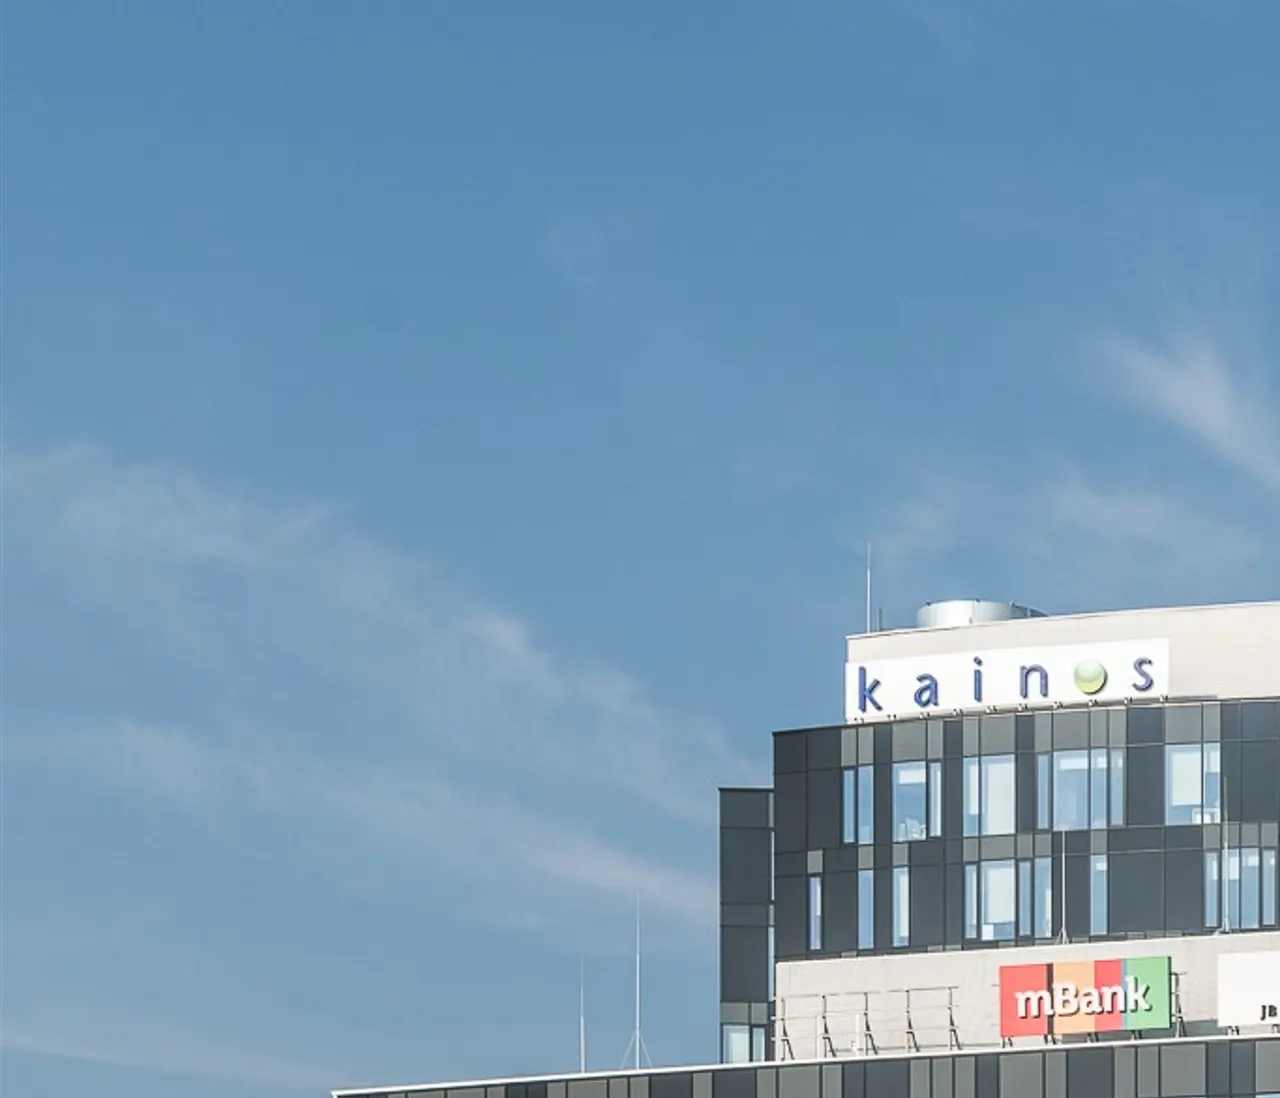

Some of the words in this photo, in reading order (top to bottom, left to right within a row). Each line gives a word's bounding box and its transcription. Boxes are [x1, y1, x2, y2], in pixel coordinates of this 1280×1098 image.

[858, 656, 1155, 713] kainos
[1015, 975, 1153, 1019] mBank
[1261, 1004, 1278, 1020] JB
